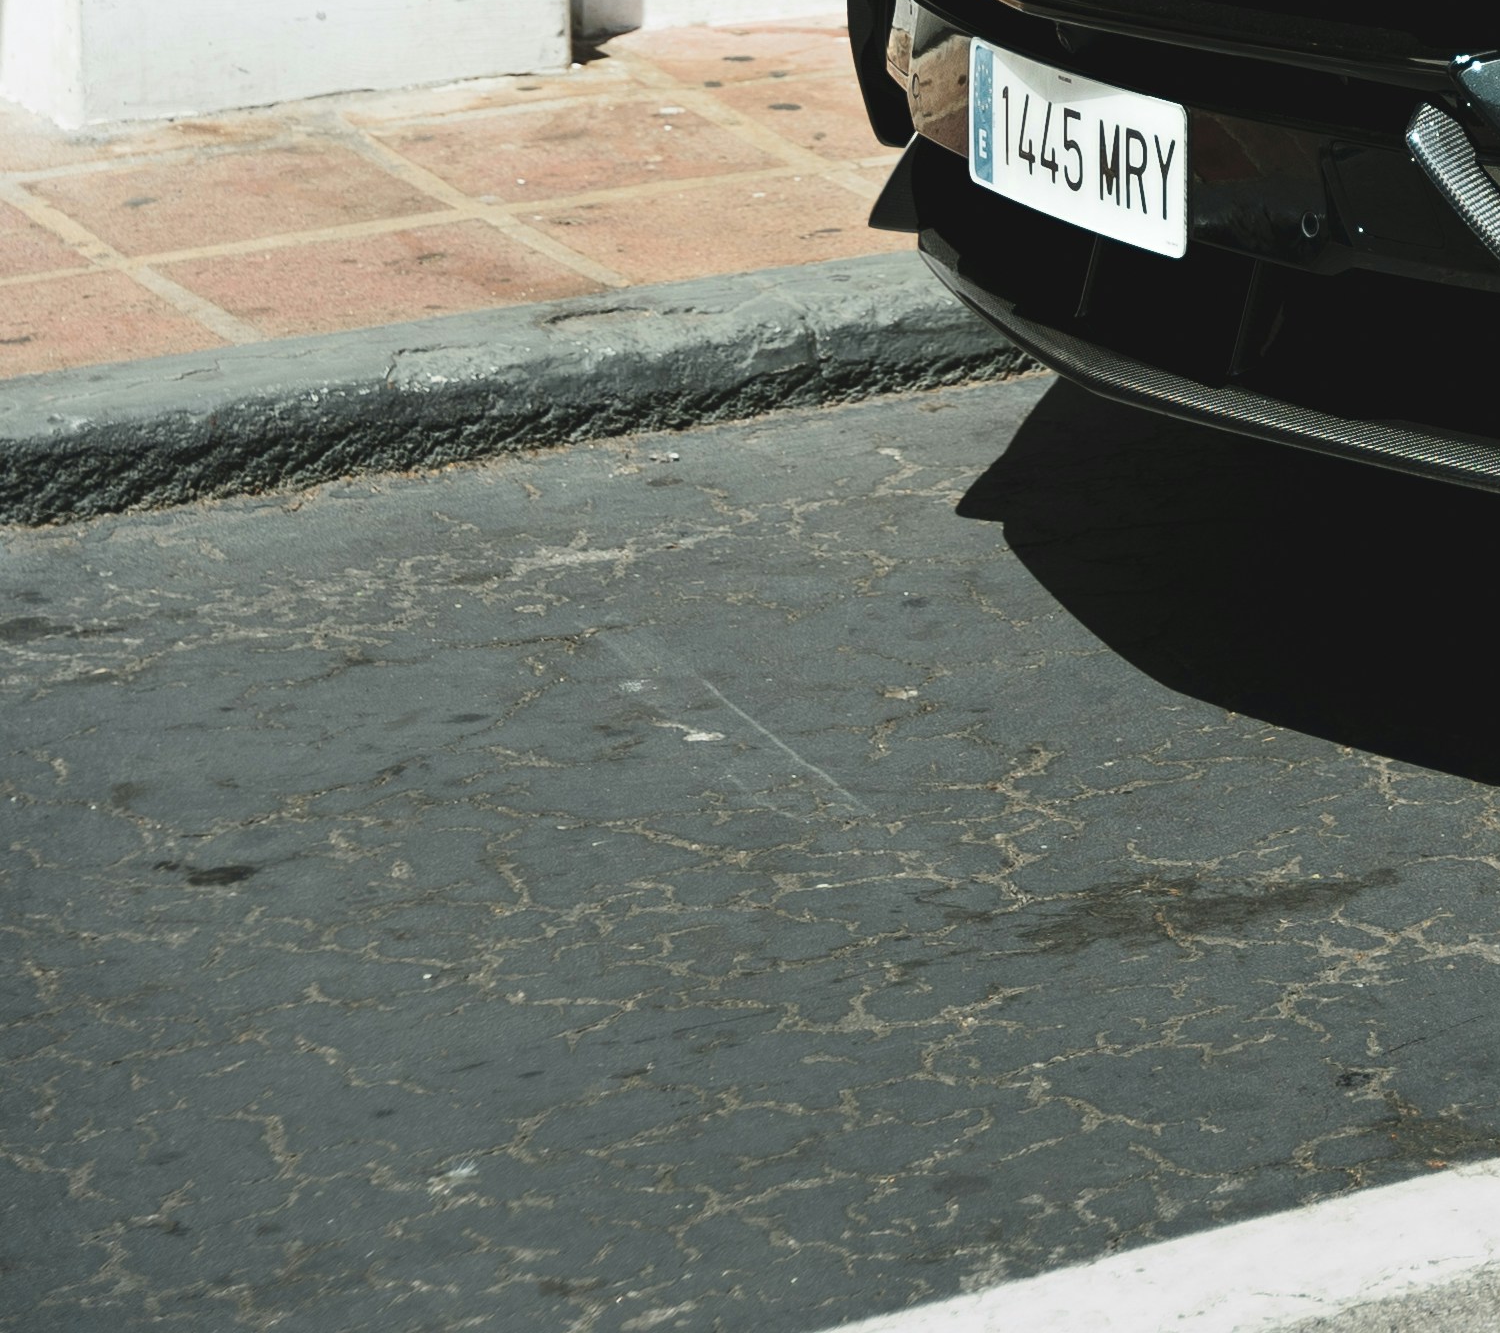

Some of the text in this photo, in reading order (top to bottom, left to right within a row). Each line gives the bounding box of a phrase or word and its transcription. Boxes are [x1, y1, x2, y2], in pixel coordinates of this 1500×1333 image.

[977, 127, 989, 160] E
[1001, 85, 1176, 221] 1445 MRY
